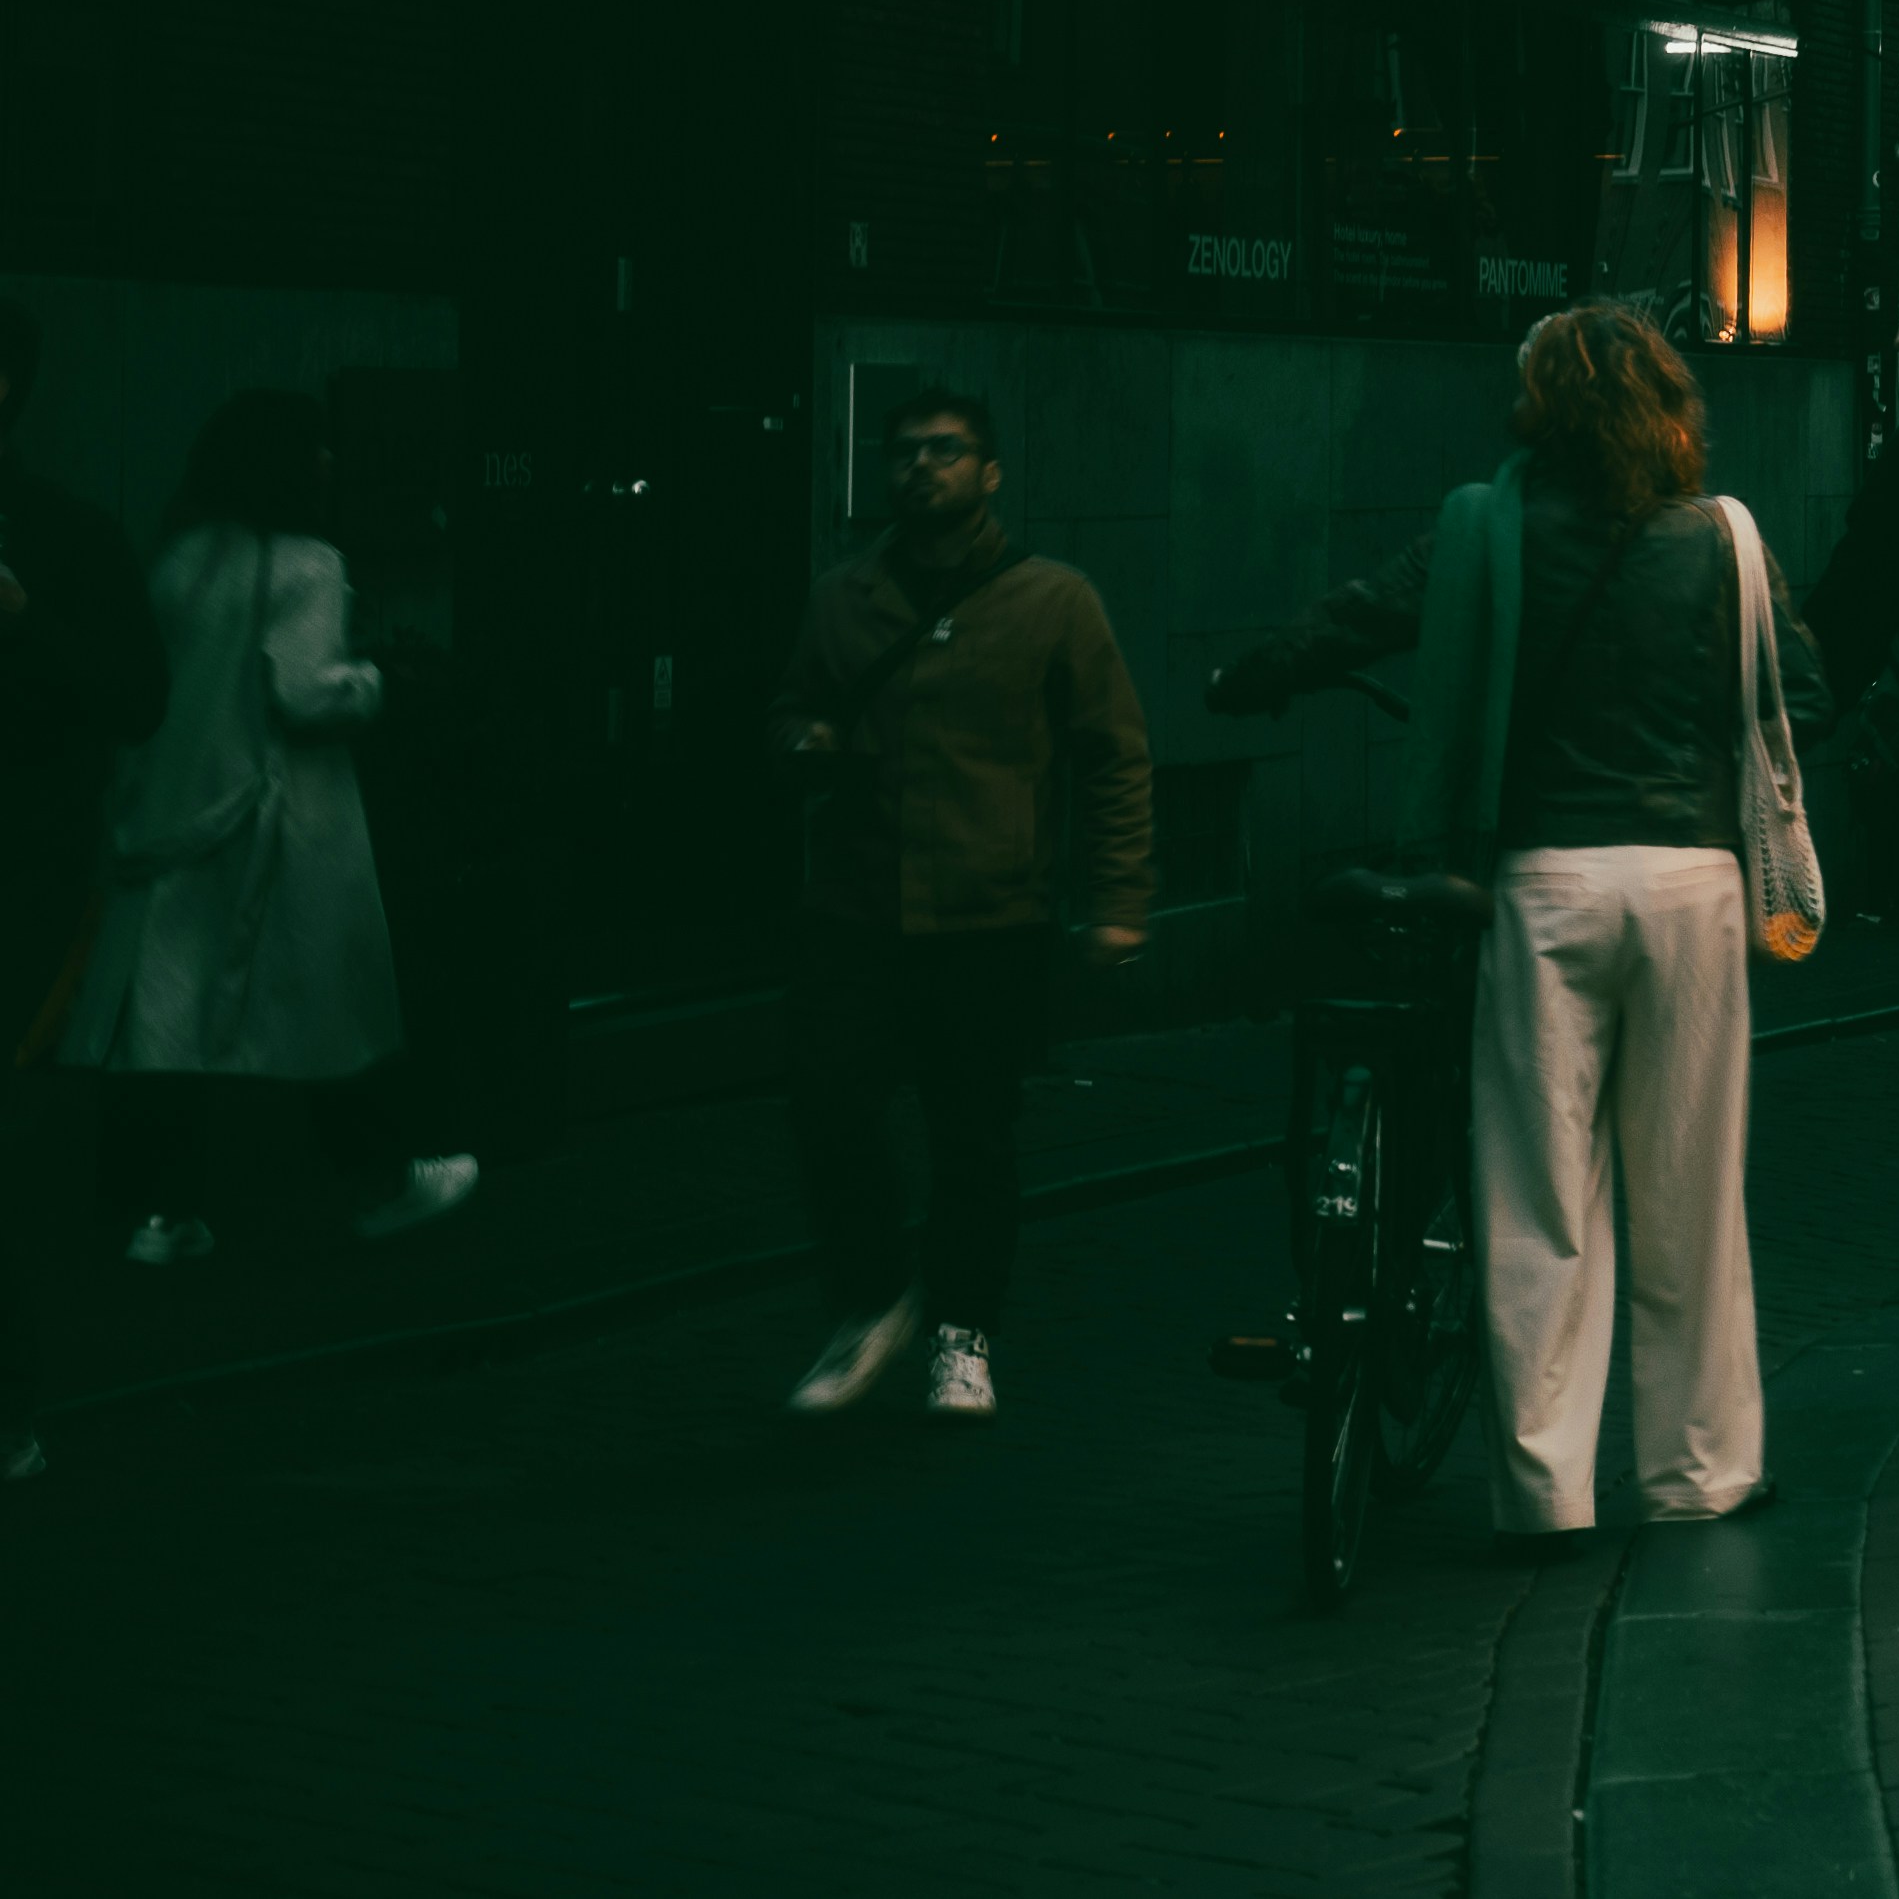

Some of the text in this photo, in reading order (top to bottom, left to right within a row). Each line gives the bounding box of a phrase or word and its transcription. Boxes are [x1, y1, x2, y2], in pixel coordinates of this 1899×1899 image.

[1188, 233, 1291, 281] ZENOLOGY
[1480, 256, 1568, 299] PANTOMIME
[1316, 1195, 1359, 1218] 219
